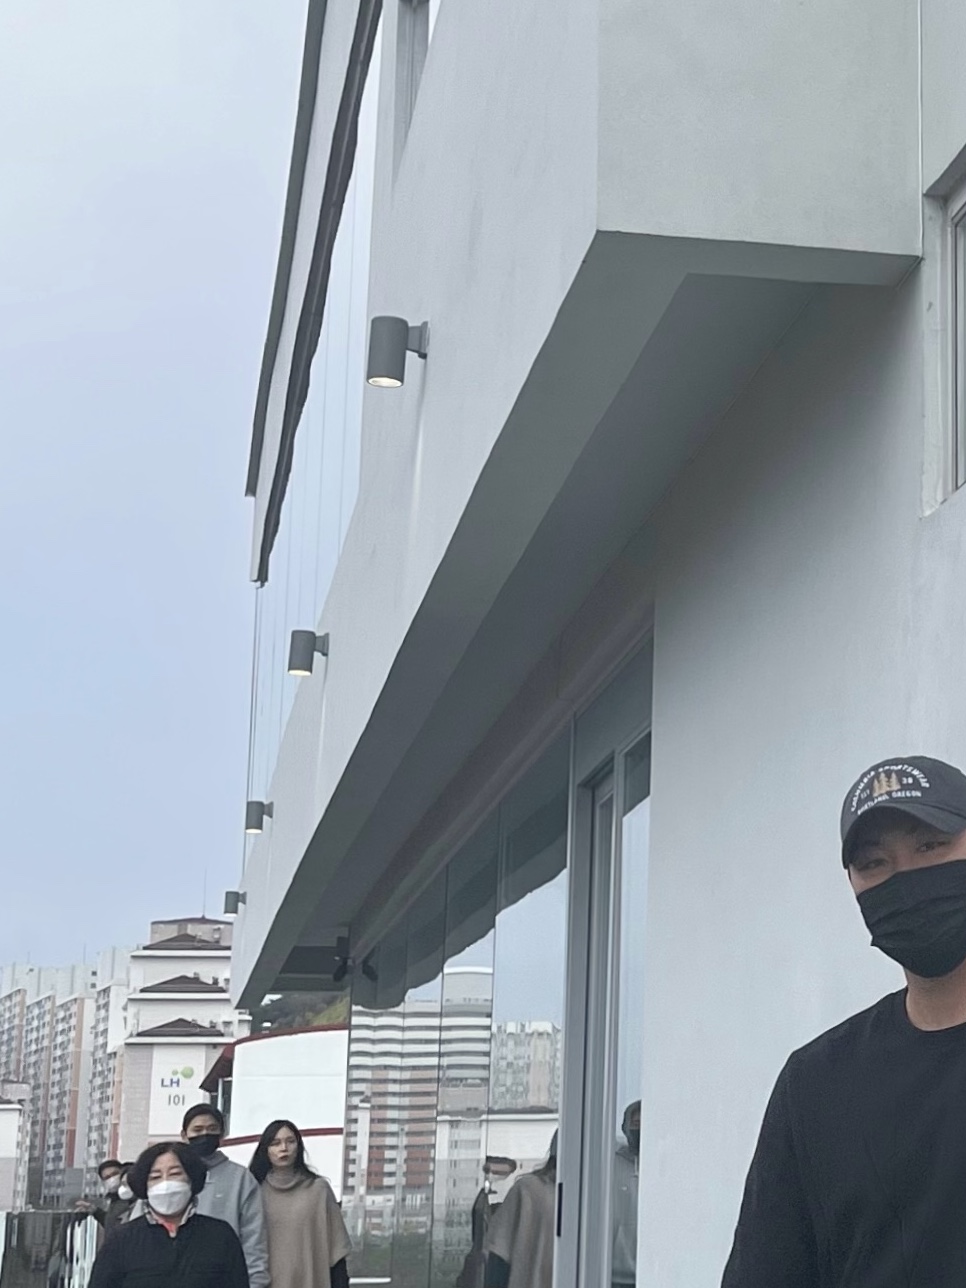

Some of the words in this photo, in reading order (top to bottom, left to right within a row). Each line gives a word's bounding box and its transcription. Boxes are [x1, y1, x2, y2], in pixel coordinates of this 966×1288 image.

[891, 790, 922, 798] OREGON
[161, 1078, 180, 1088] LH
[168, 1094, 185, 1106] 101
